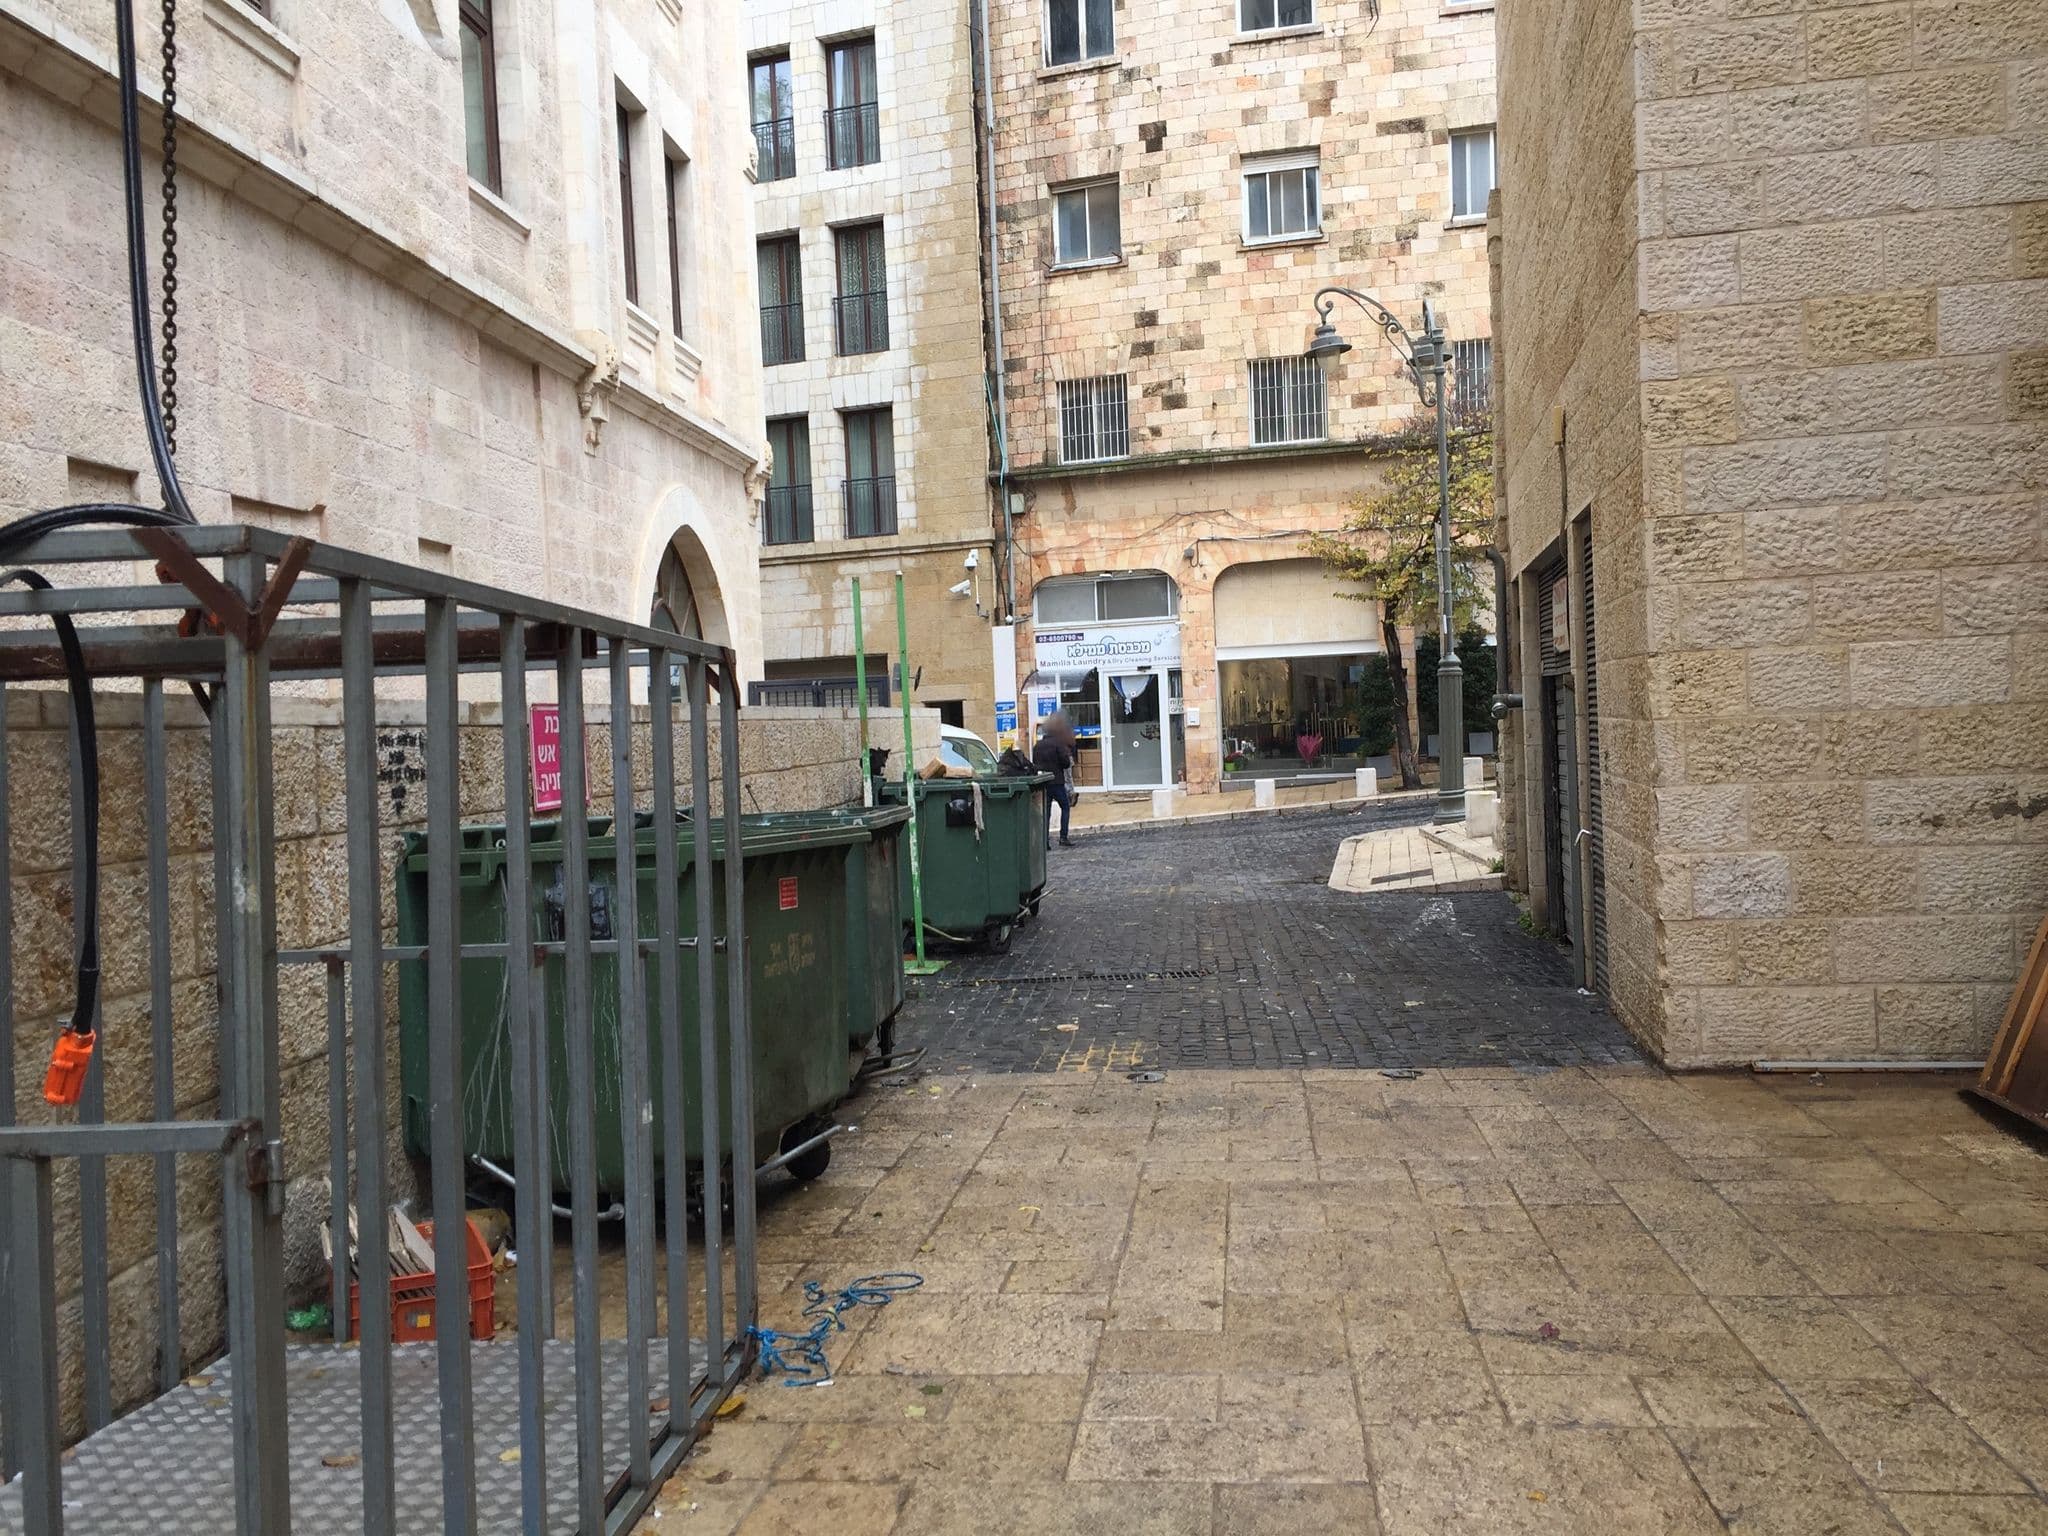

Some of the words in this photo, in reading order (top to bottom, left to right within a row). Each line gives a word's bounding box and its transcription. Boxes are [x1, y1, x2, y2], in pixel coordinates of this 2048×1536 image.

[1067, 642, 1107, 657] ממילא
[1108, 641, 1151, 656] מכבסת
[1040, 658, 1071, 667] Mamilla
[1072, 657, 1106, 666] Laundry
[1154, 653, 1181, 661] Services
[537, 744, 556, 764] אש
